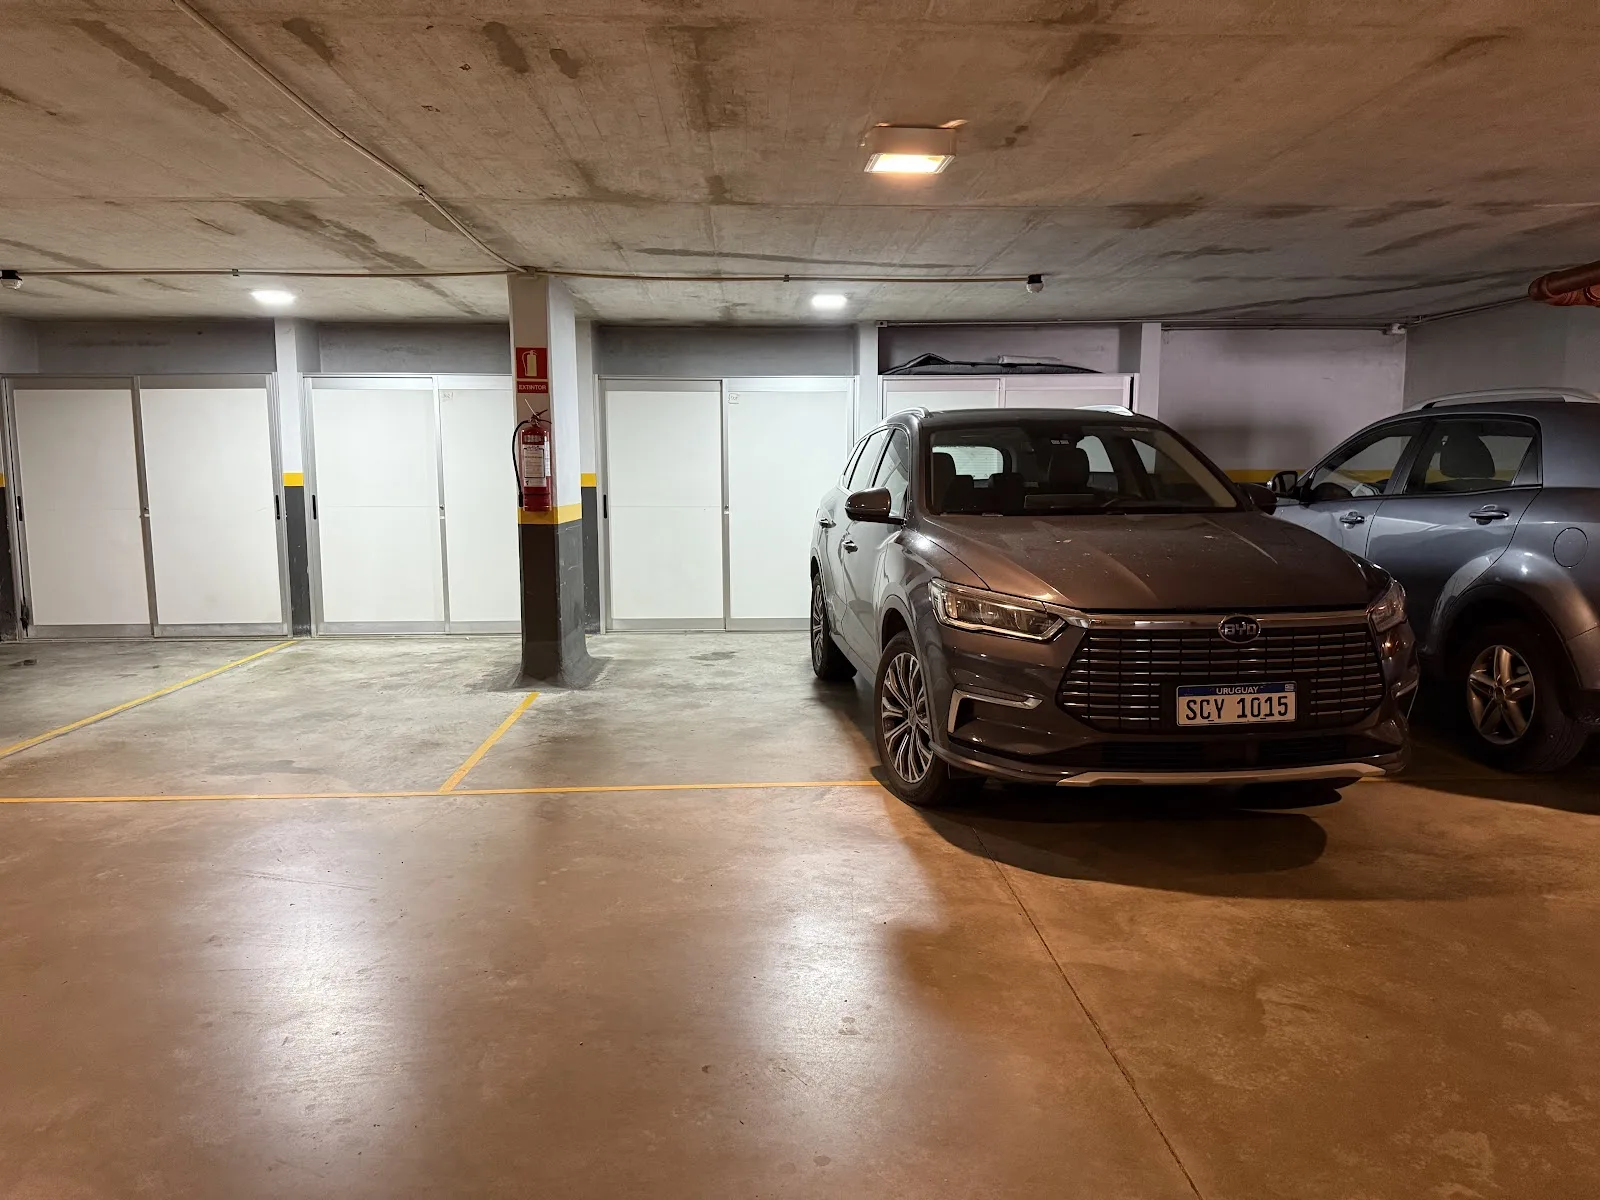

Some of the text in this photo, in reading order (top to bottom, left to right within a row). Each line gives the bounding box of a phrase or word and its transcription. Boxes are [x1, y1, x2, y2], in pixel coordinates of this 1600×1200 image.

[1224, 623, 1257, 635] BYD
[1216, 686, 1259, 695] URUGUAY
[1185, 696, 1288, 720] SCY 1015
